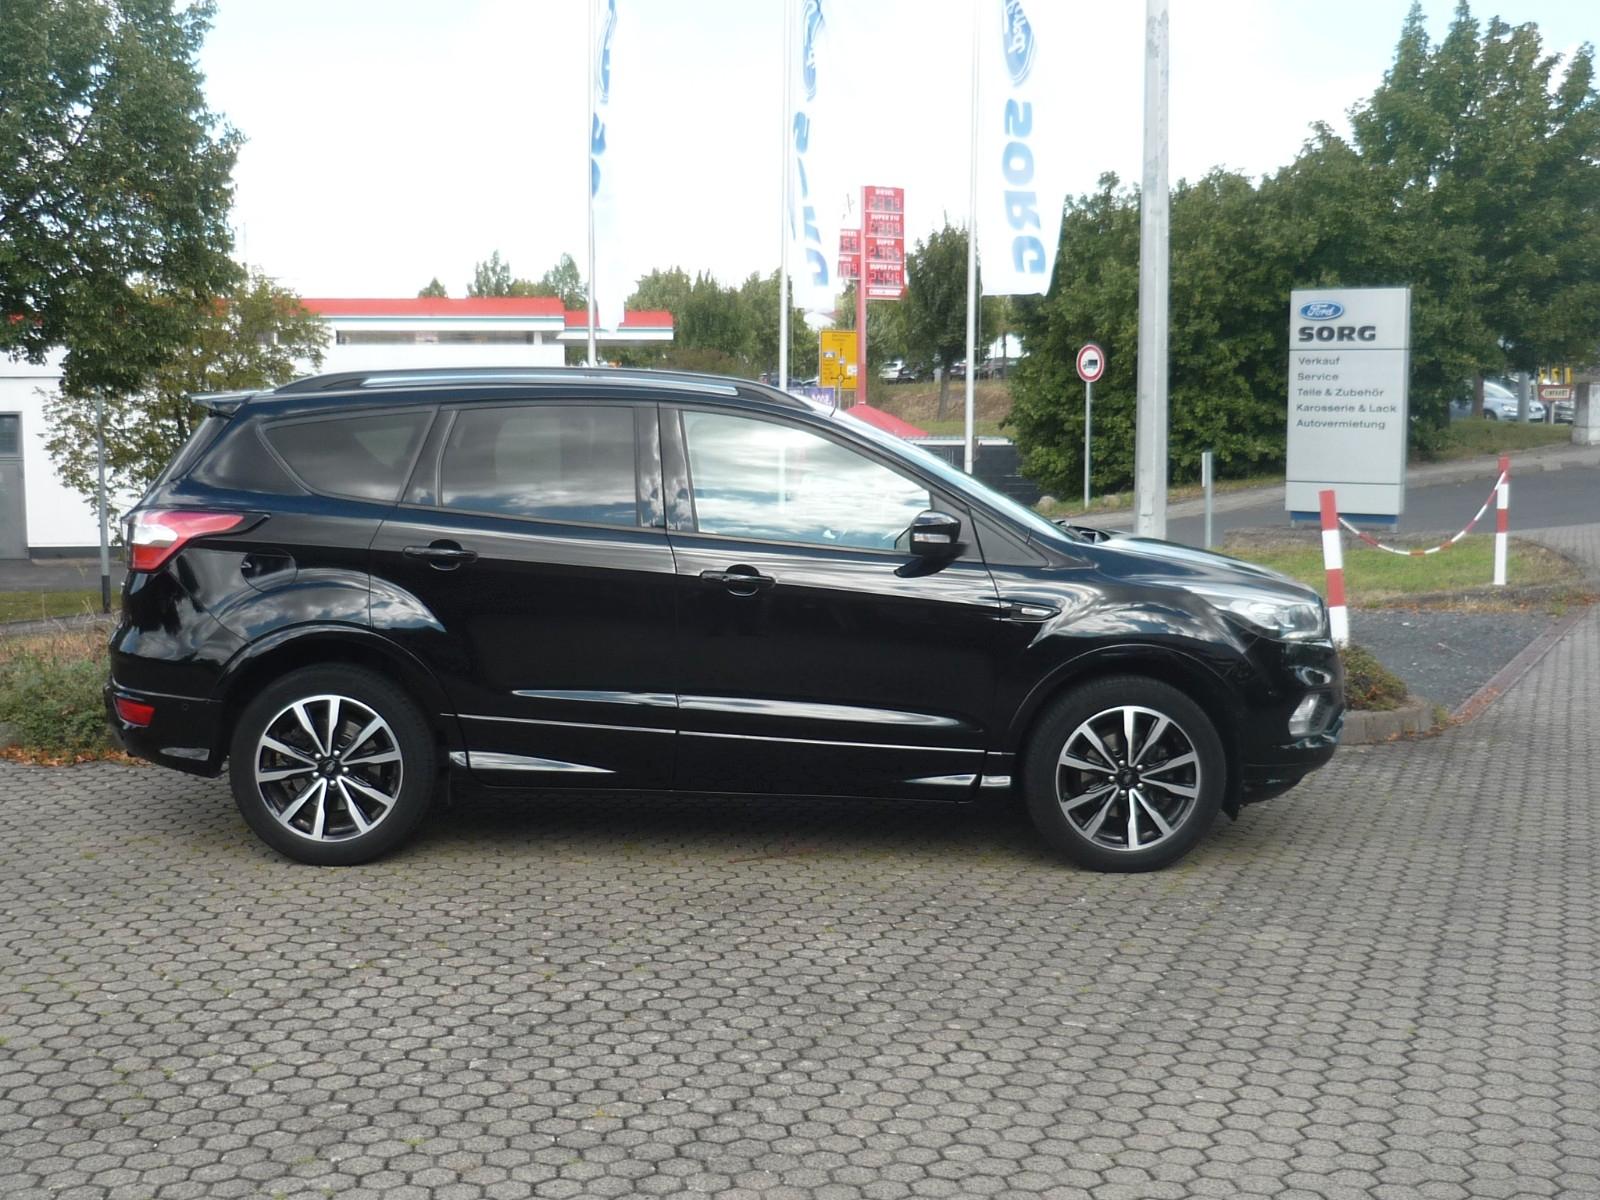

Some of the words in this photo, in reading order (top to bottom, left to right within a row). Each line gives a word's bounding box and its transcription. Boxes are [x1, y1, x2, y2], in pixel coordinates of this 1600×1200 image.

[1298, 326, 1376, 342] SORG
[1298, 357, 1340, 366] Verkauf
[1297, 372, 1339, 381] Service
[1297, 388, 1322, 396] Teile
[1324, 388, 1332, 396] &
[1335, 388, 1384, 397] Zubehör
[1296, 403, 1355, 412] Karosserie
[1358, 404, 1366, 412] &
[1368, 404, 1397, 413] Lack
[1296, 419, 1386, 430] Autovermietung
